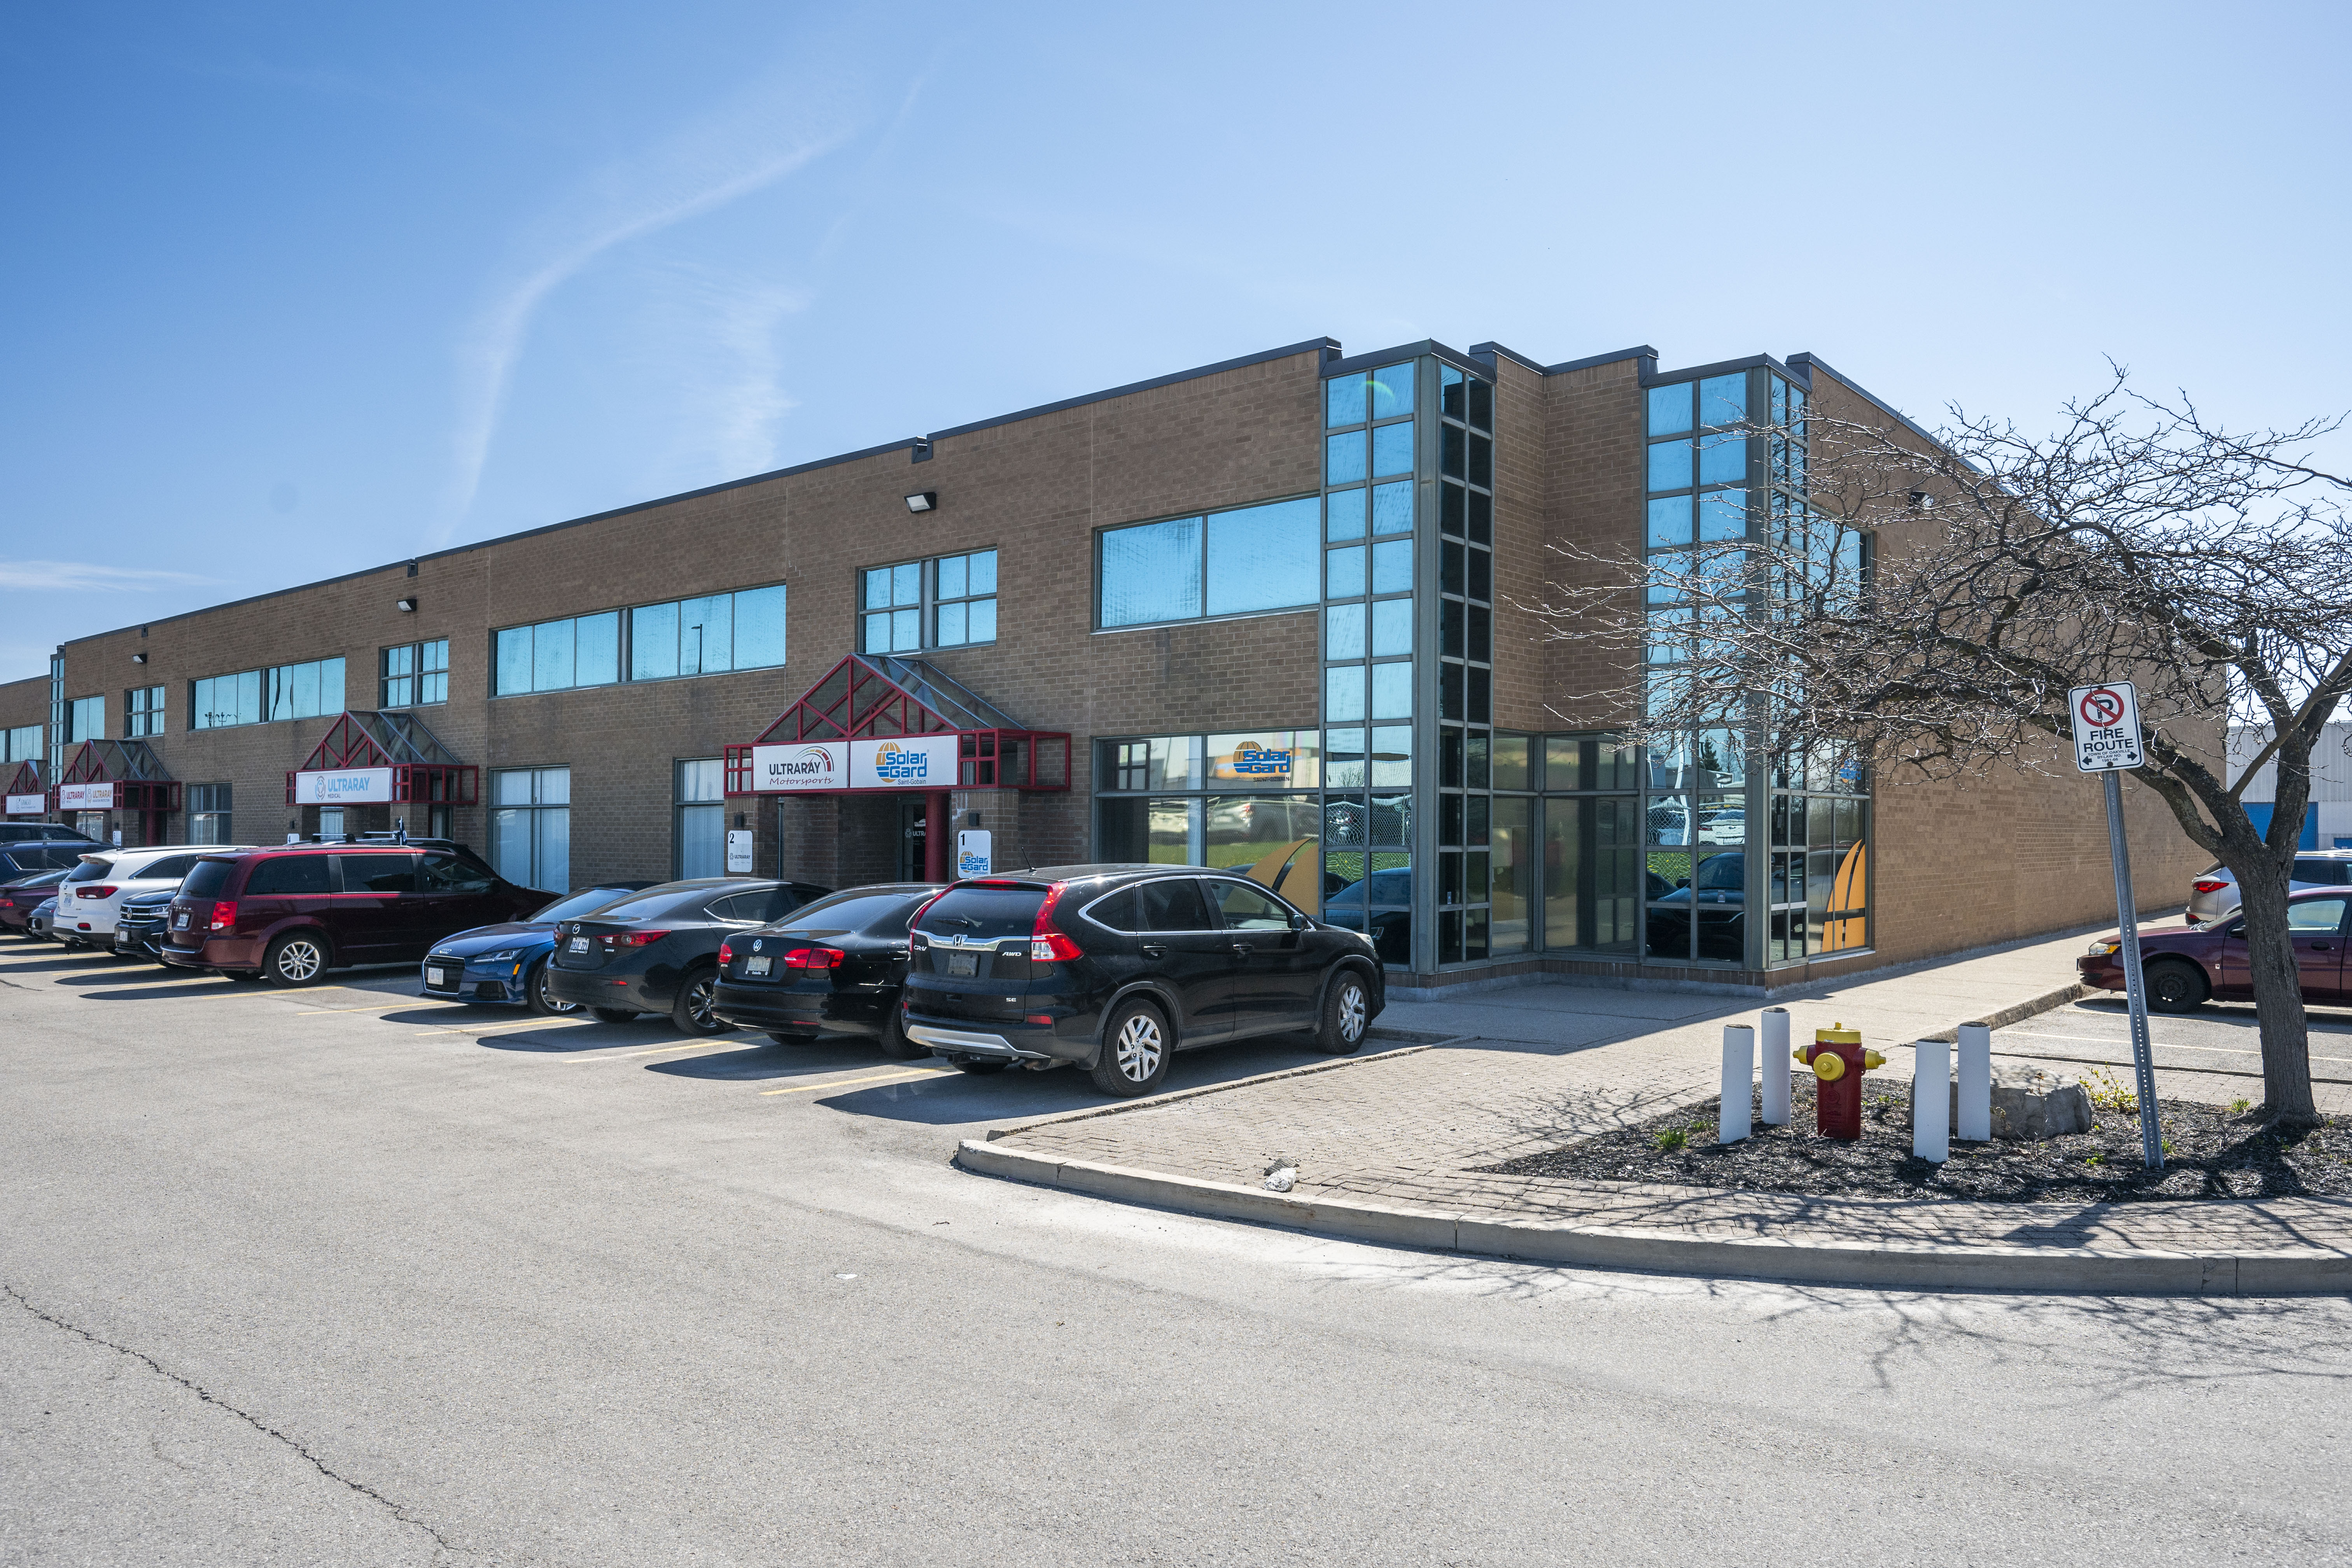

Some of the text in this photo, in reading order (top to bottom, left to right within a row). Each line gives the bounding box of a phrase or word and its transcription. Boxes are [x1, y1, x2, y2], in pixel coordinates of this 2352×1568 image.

[2090, 728, 2124, 741] FIRE
[2083, 738, 2134, 752] ROUTE
[886, 750, 927, 765] Solar
[1244, 749, 1290, 761] Solar
[769, 762, 821, 775] ULTRARAY
[890, 758, 927, 778] Gard
[1248, 755, 1290, 774] Gard
[328, 777, 370, 792] ULTRARAY
[769, 776, 834, 786] Motorsports
[66, 791, 85, 799] ULTRARAY
[93, 790, 112, 798] ULTRARAY
[730, 833, 734, 844] 2
[961, 833, 965, 846] 1
[967, 860, 988, 871] Gard
